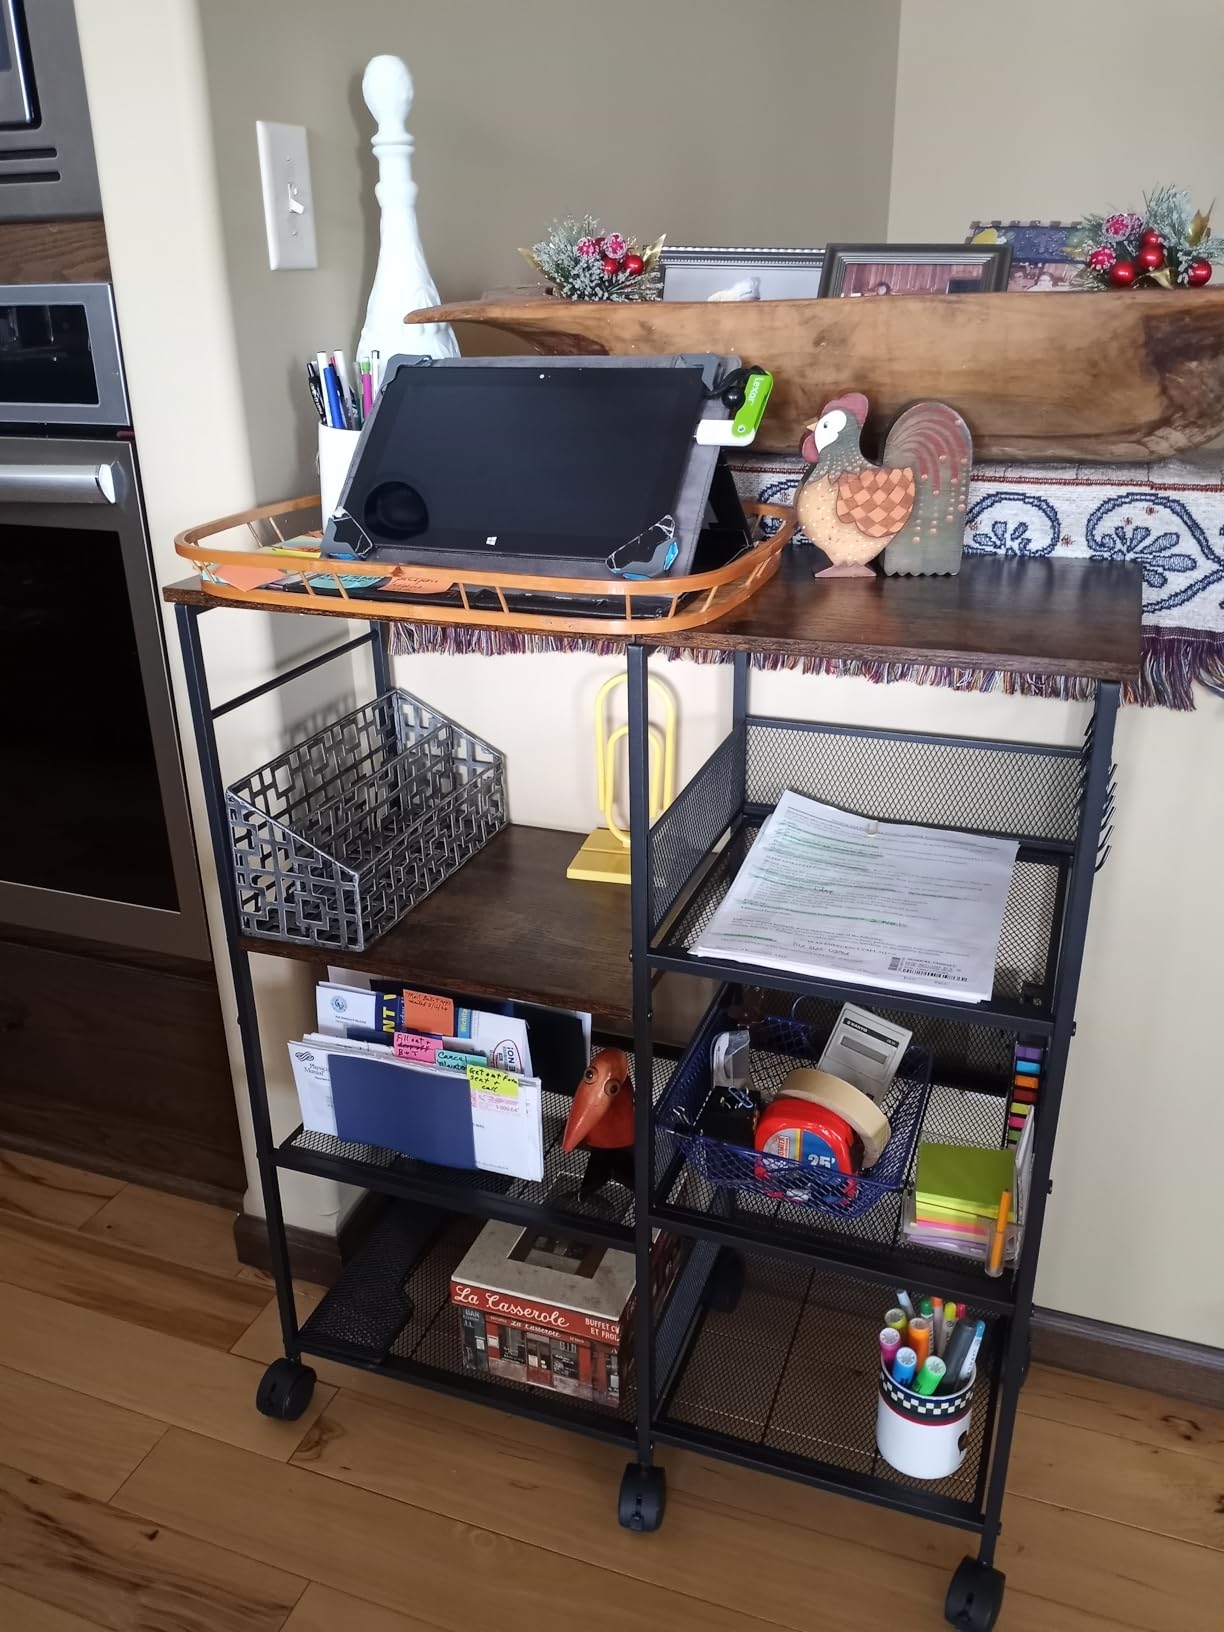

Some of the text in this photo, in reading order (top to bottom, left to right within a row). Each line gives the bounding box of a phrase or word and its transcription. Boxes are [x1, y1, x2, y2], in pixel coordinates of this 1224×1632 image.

[748, 377, 764, 406] Lexar
[454, 1285, 570, 1327] La Casserole
[585, 1317, 610, 1330] BUFFET
[590, 1327, 620, 1342] ET FROI
